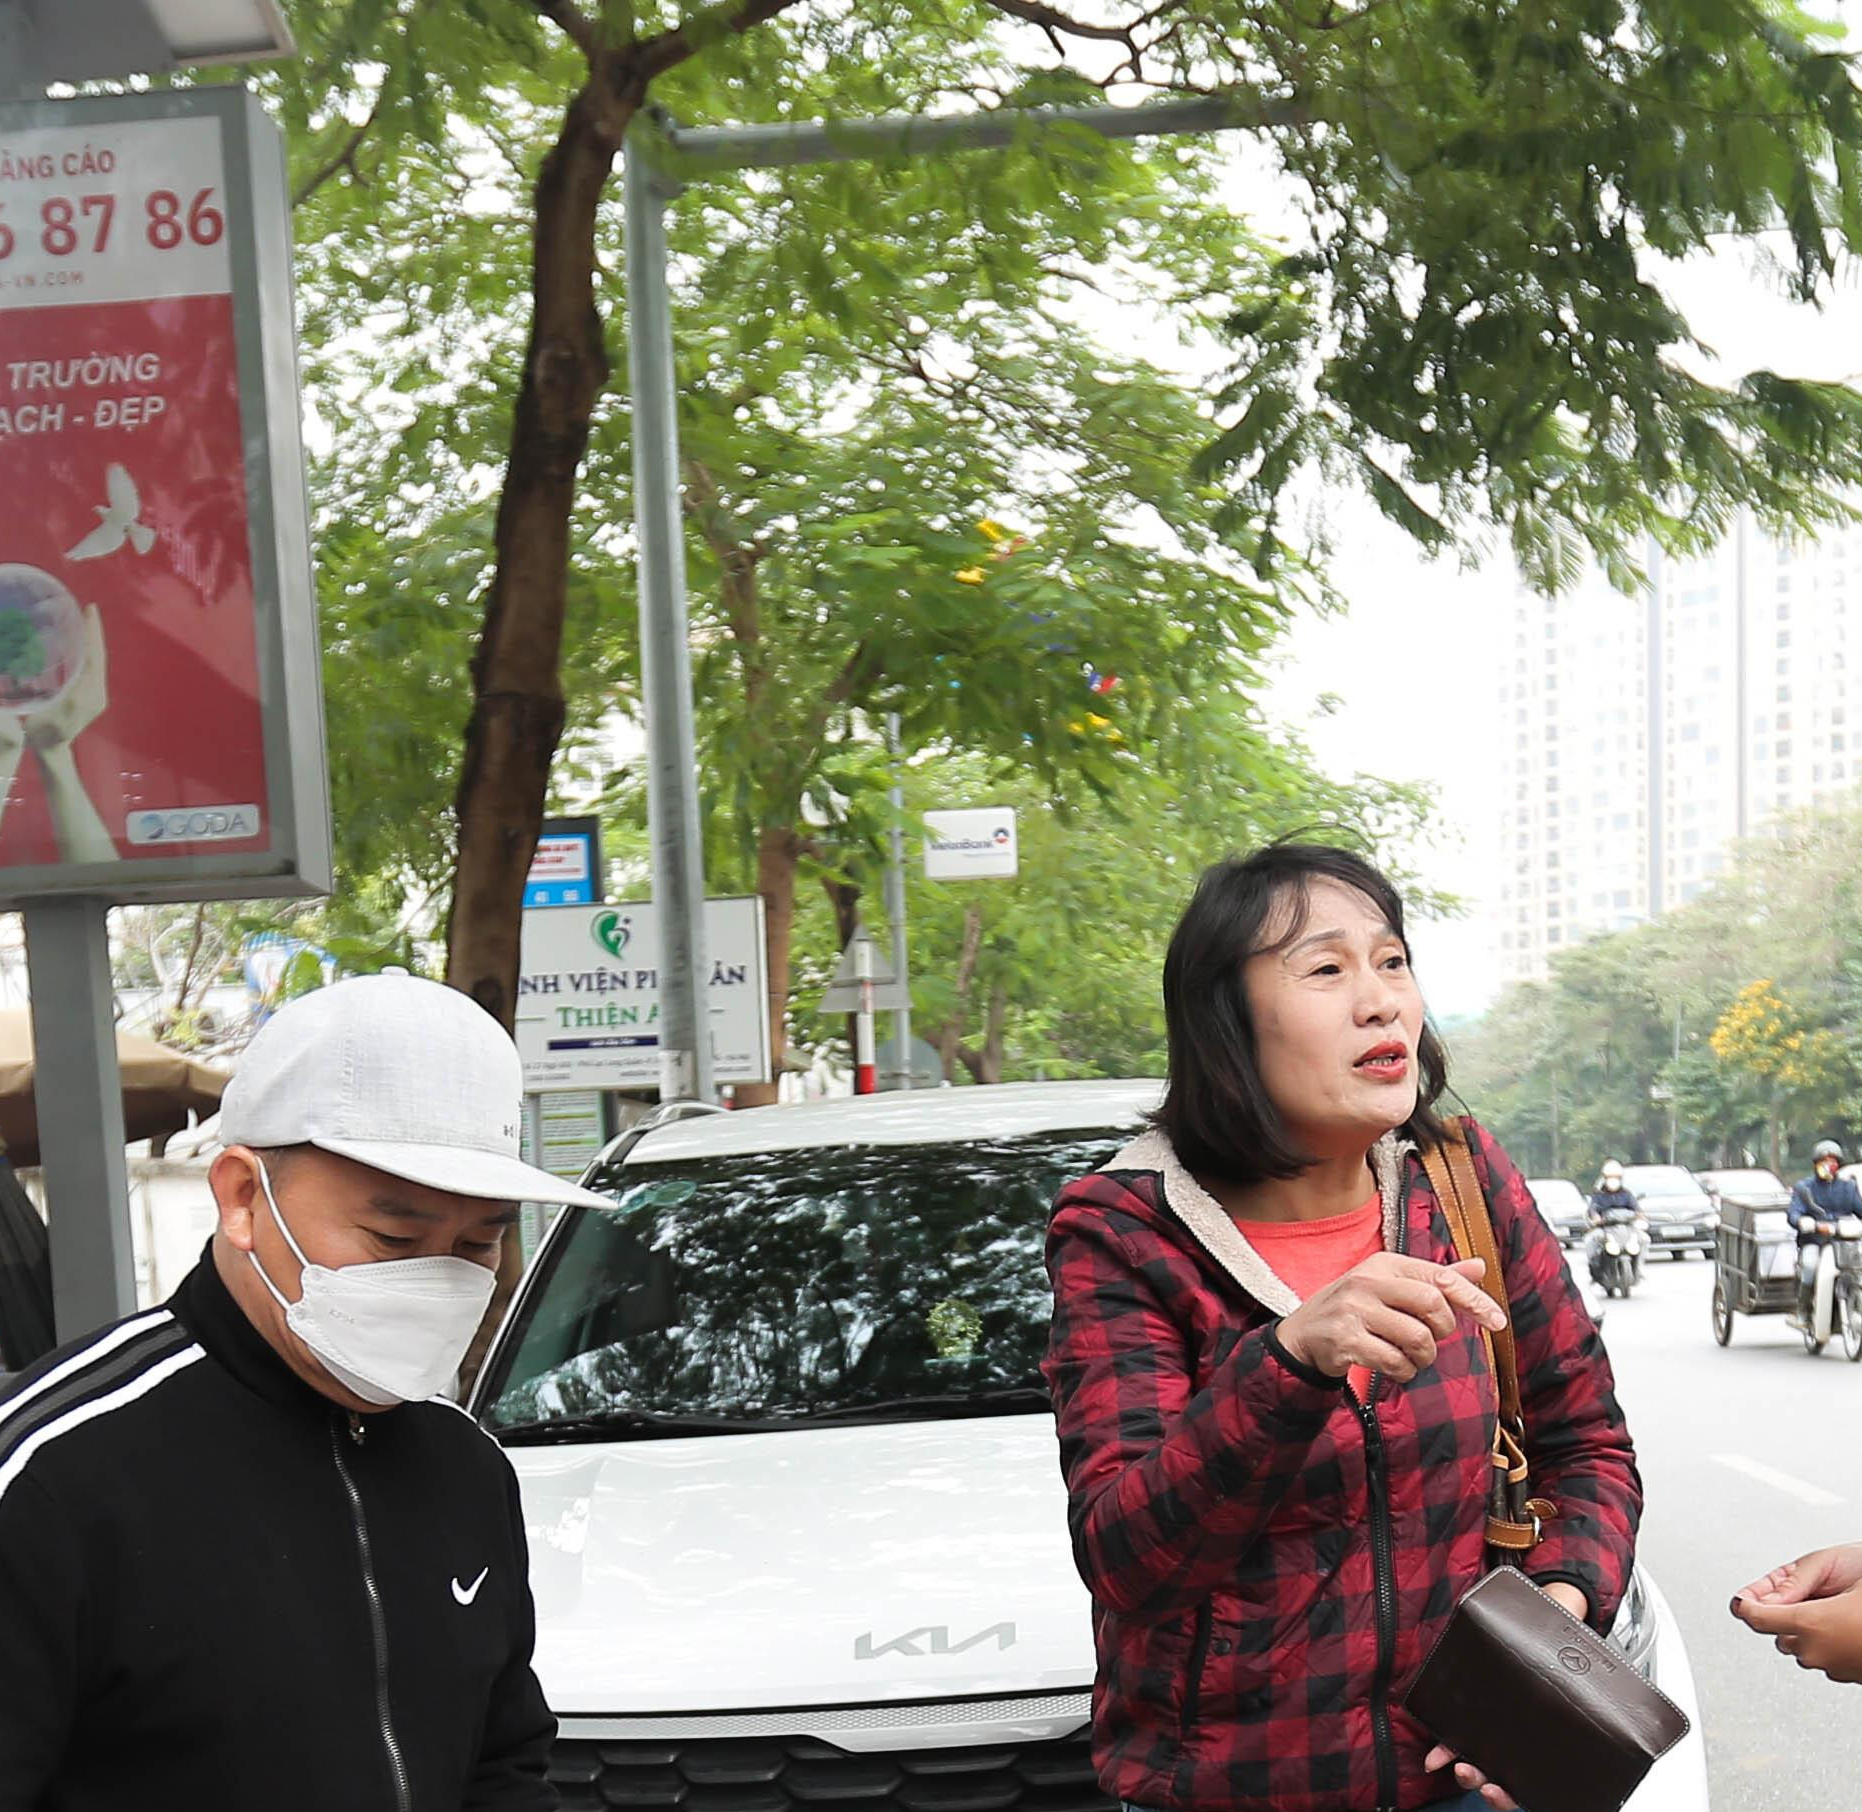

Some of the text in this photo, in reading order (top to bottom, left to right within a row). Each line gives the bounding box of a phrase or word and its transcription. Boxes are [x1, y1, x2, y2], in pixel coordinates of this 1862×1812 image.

[62, 143, 115, 176] CÁO
[40, 194, 117, 256] 87
[144, 187, 225, 251] 86
[7, 351, 161, 391] TRƯỜNG
[93, 396, 166, 432] ĐẸP
[166, 811, 248, 836] GODA
[519, 973, 561, 996] NH
[569, 966, 629, 996] VIỆN
[709, 960, 747, 986] ẢN
[556, 1001, 639, 1030] THIỆN
[854, 1621, 1017, 1661] KIA
